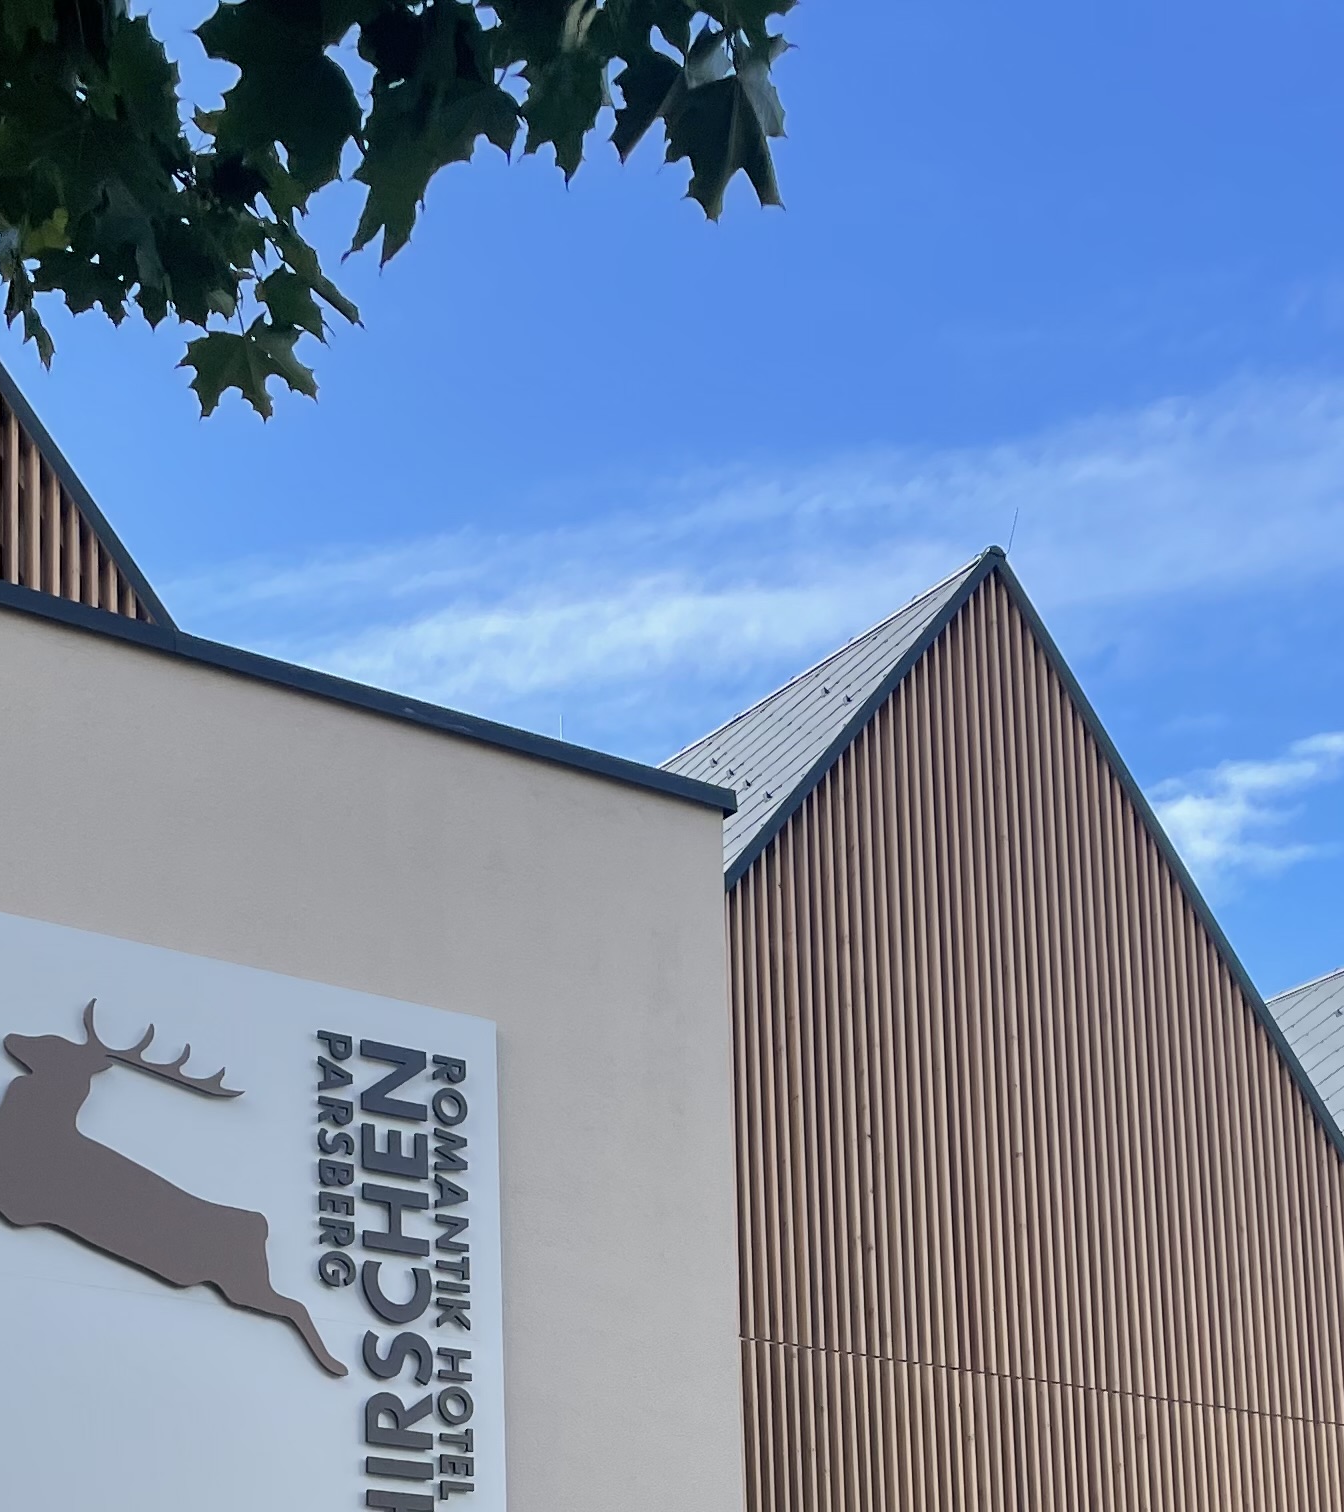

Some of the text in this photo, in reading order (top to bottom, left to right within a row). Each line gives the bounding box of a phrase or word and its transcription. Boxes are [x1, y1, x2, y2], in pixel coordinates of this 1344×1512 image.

[316, 1029, 356, 1288] PARSBERG
[431, 1054, 475, 1501] ROMANTIK HOTEL
